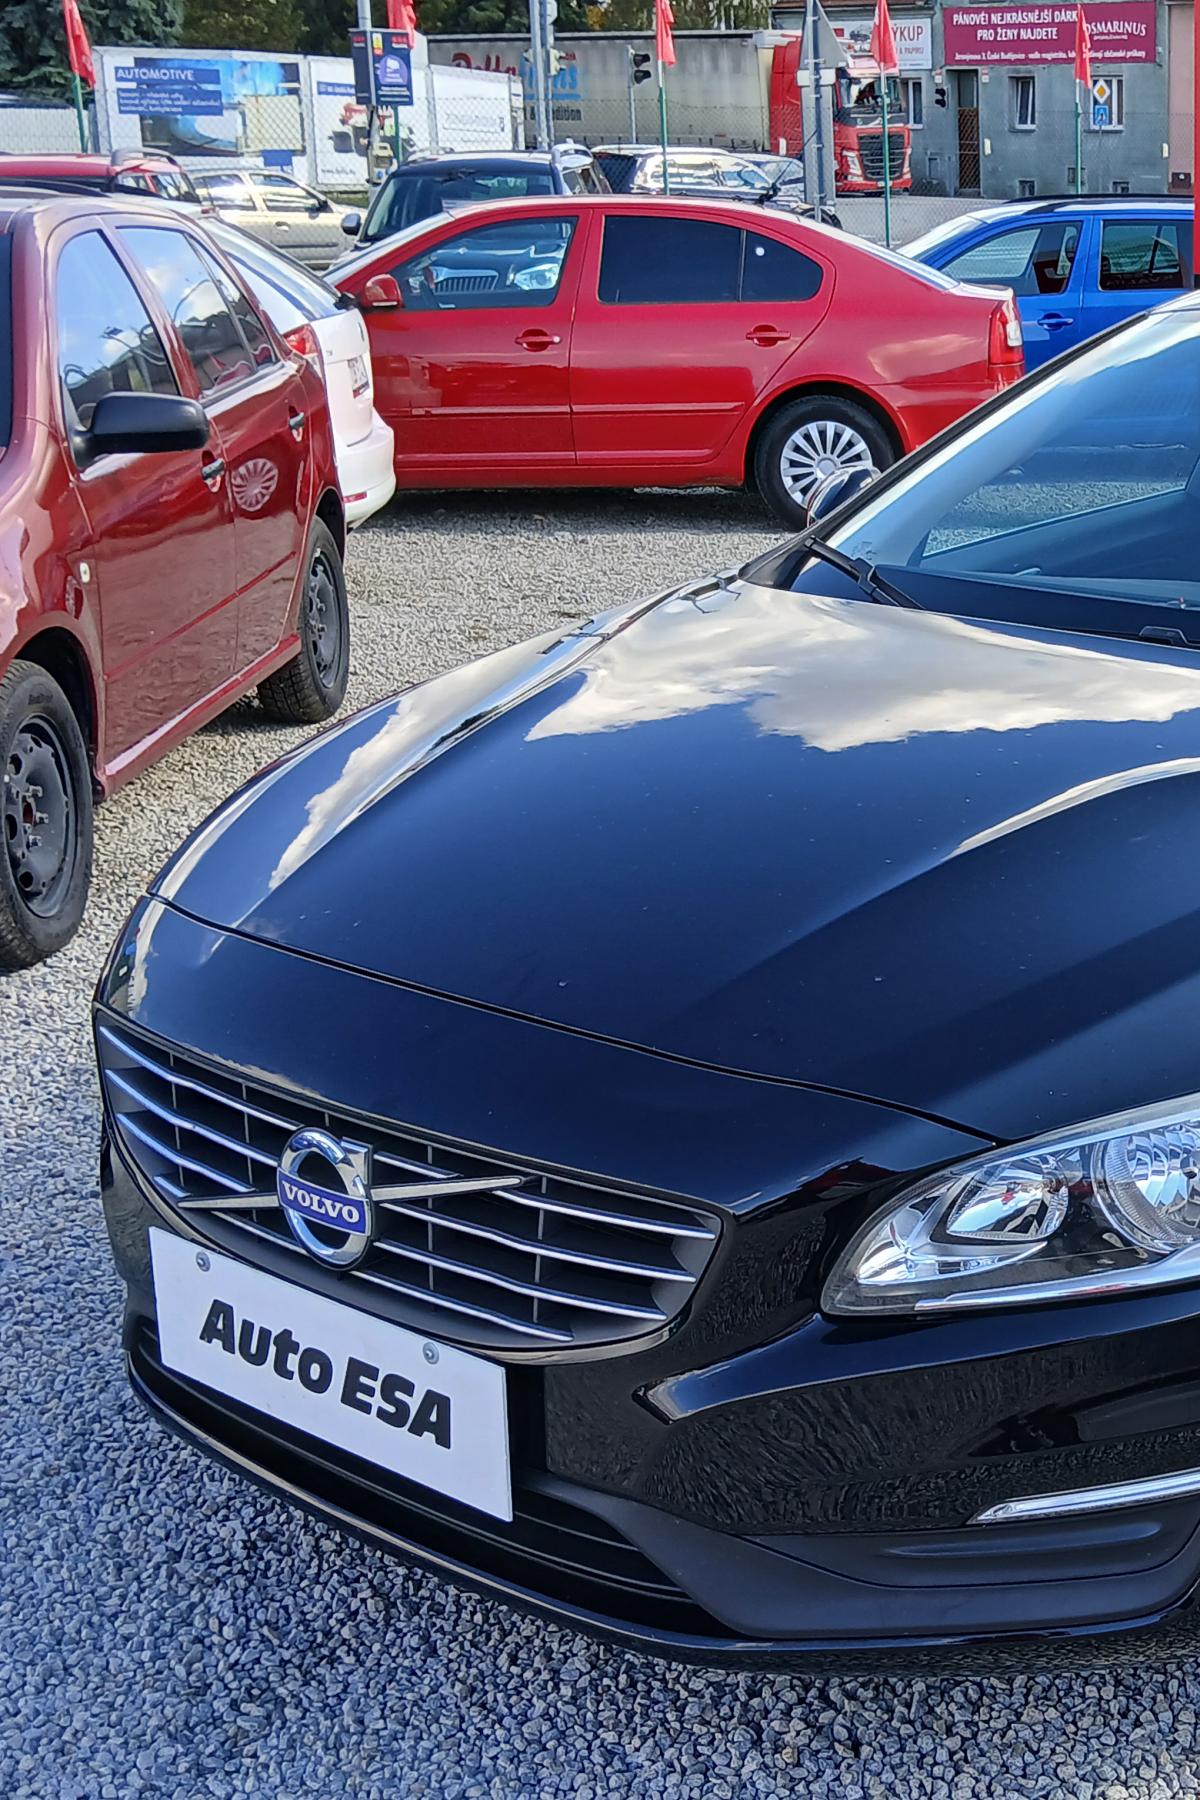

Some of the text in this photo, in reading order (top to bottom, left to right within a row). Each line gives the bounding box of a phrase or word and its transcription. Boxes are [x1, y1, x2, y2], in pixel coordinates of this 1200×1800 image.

[953, 9, 1078, 25] PÁNOVÉ! NEJKRÁSNĚJŠÍ DÁRK
[891, 23, 924, 42] ÝKUP
[977, 27, 1058, 40] PRO ŽENY NAJDETE
[1085, 20, 1147, 36] OSMARINUS
[116, 67, 195, 80] AUTOMOTIVE
[282, 1181, 360, 1225] VOLVO
